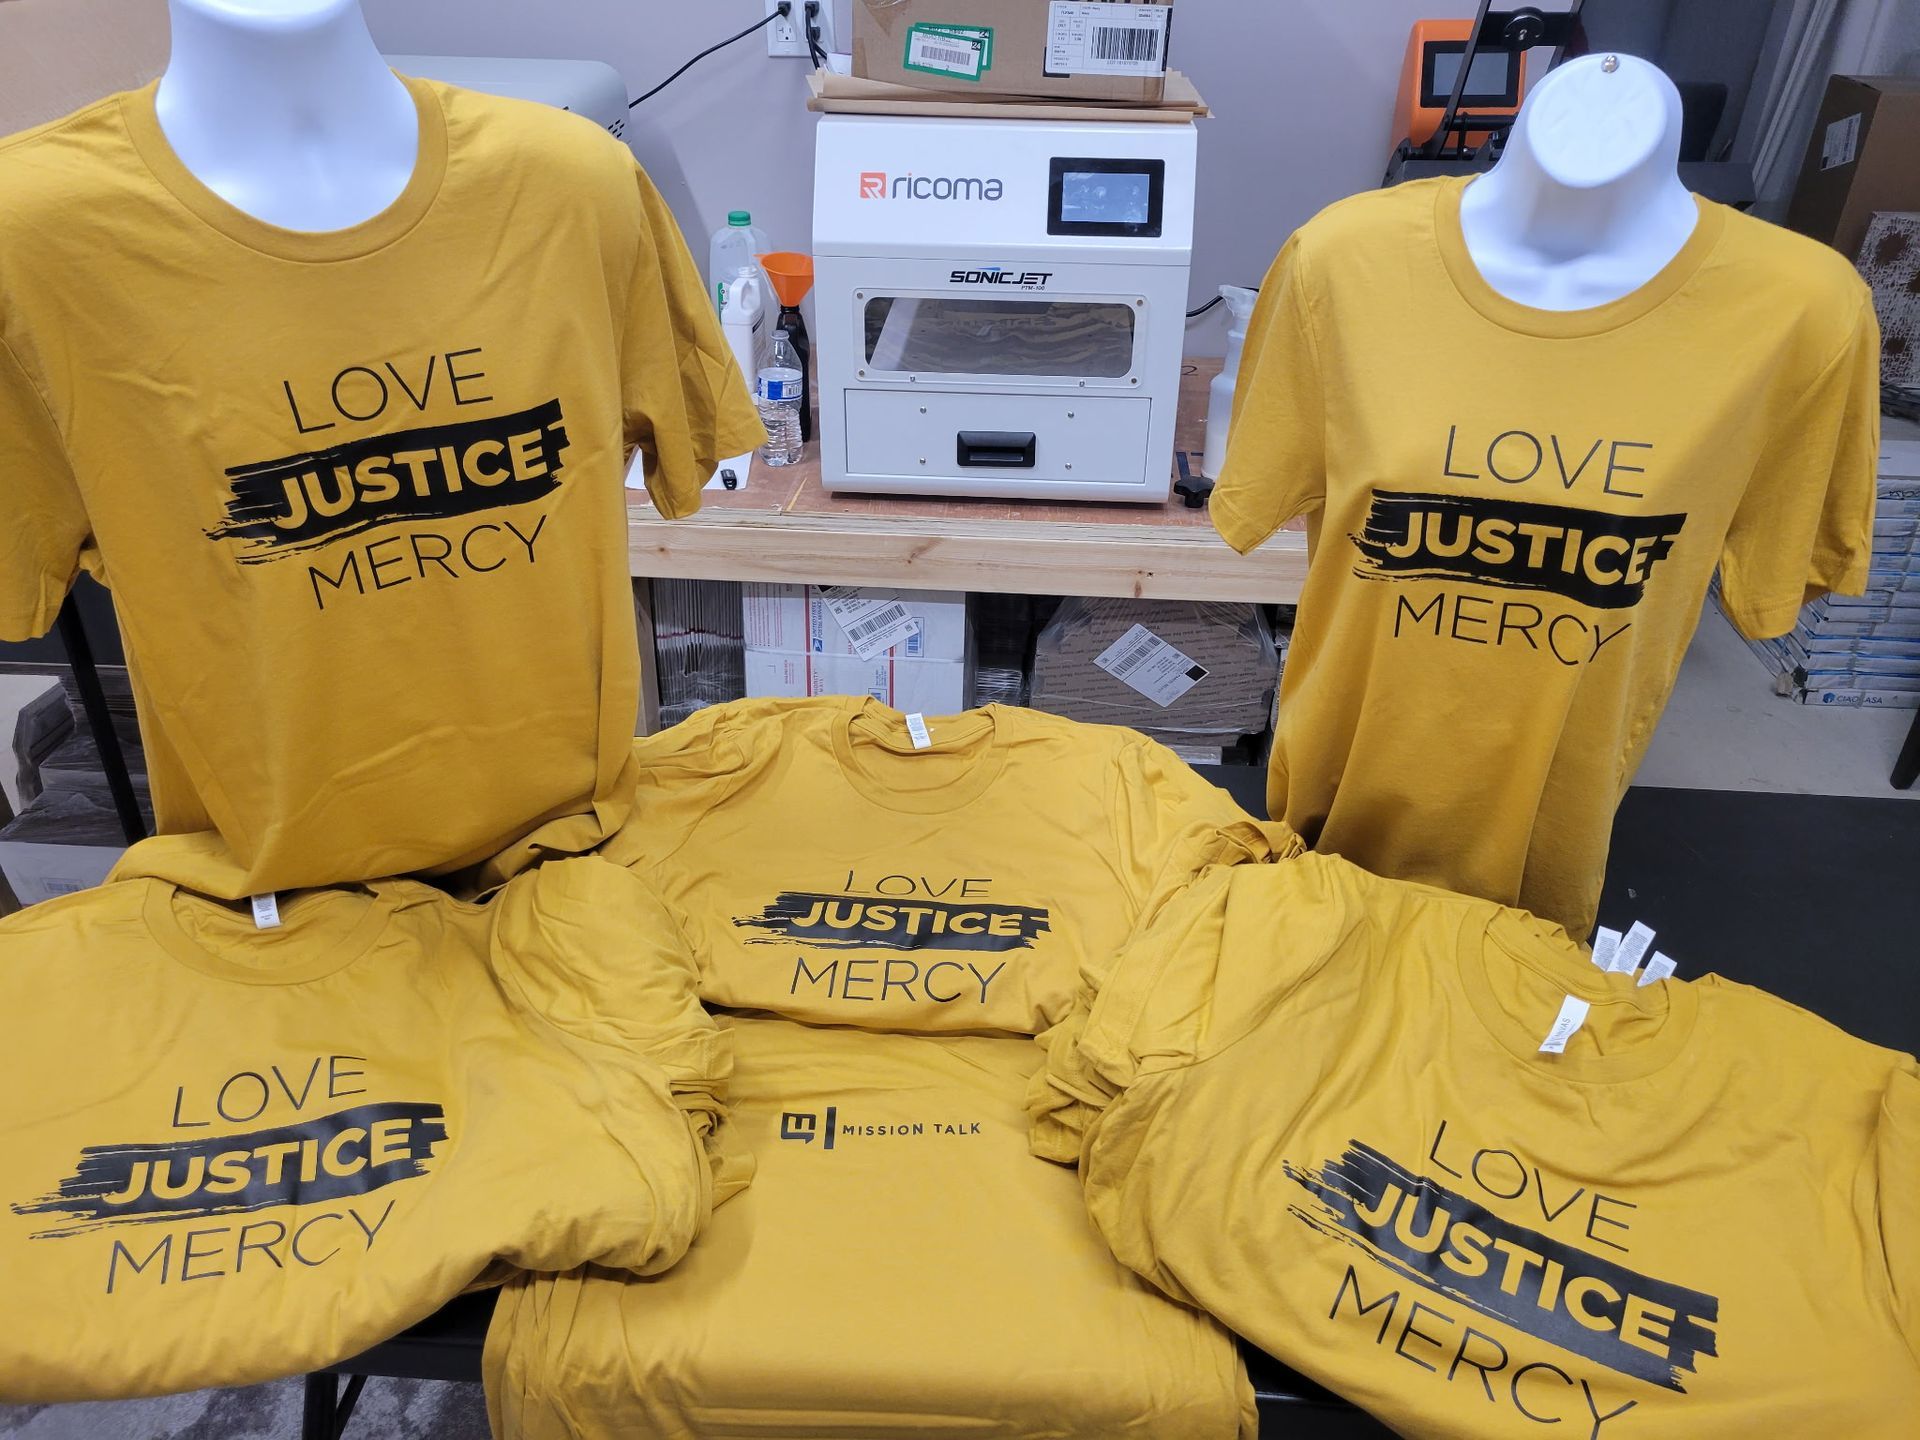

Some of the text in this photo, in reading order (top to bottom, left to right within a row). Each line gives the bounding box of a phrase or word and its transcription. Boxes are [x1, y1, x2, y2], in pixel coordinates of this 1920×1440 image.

[892, 172, 1003, 201] ricoma
[949, 270, 1053, 285] SONICJET
[283, 347, 494, 434] LOVE
[273, 428, 549, 530] JUSTICE
[1443, 425, 1653, 499] LOVE
[308, 514, 547, 610] MERCY
[1385, 511, 1659, 586] JUSTICE
[1394, 592, 1632, 666] MERCY
[1837, 695, 1883, 704] CIAOASA
[790, 901, 1024, 937] JUSTICE
[844, 870, 993, 898] LOVE
[790, 957, 1007, 1004] MERCY
[172, 1055, 368, 1128] LOVE
[101, 1118, 413, 1205] JUSTICE
[842, 1122, 981, 1136] MISSION TALK
[1428, 1119, 1638, 1253] LOVE
[106, 1200, 396, 1294] MERCY
[1353, 1182, 1677, 1360] JUSTICE
[1328, 1264, 1639, 1440] MERCY
